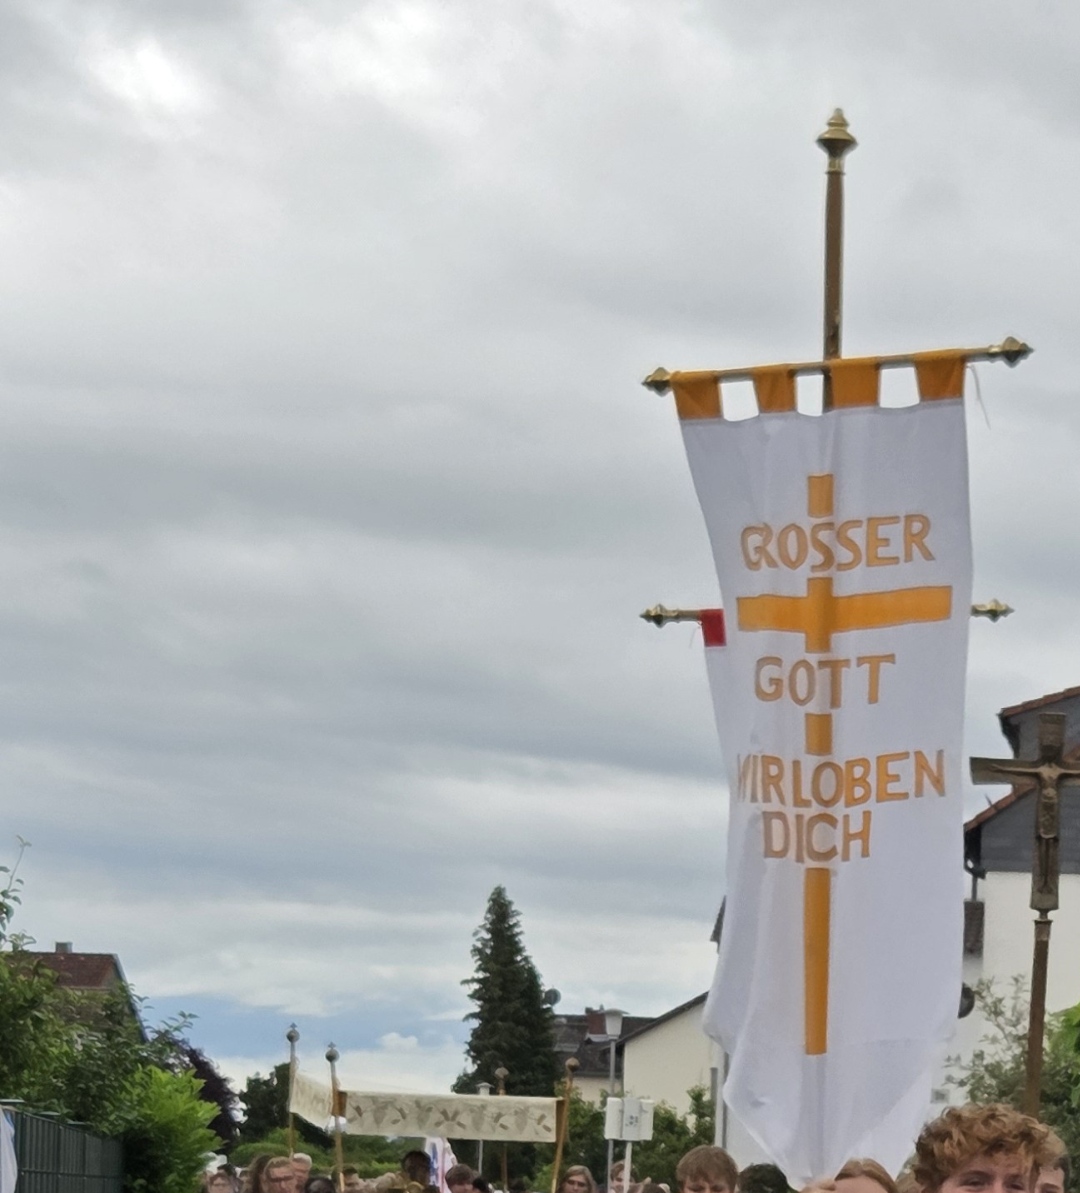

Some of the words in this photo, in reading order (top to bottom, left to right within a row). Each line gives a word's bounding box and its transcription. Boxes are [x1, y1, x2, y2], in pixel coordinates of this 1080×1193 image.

[754, 653, 896, 709] GOTT
[791, 748, 947, 808] LOBEN
[761, 809, 872, 864] DICH
